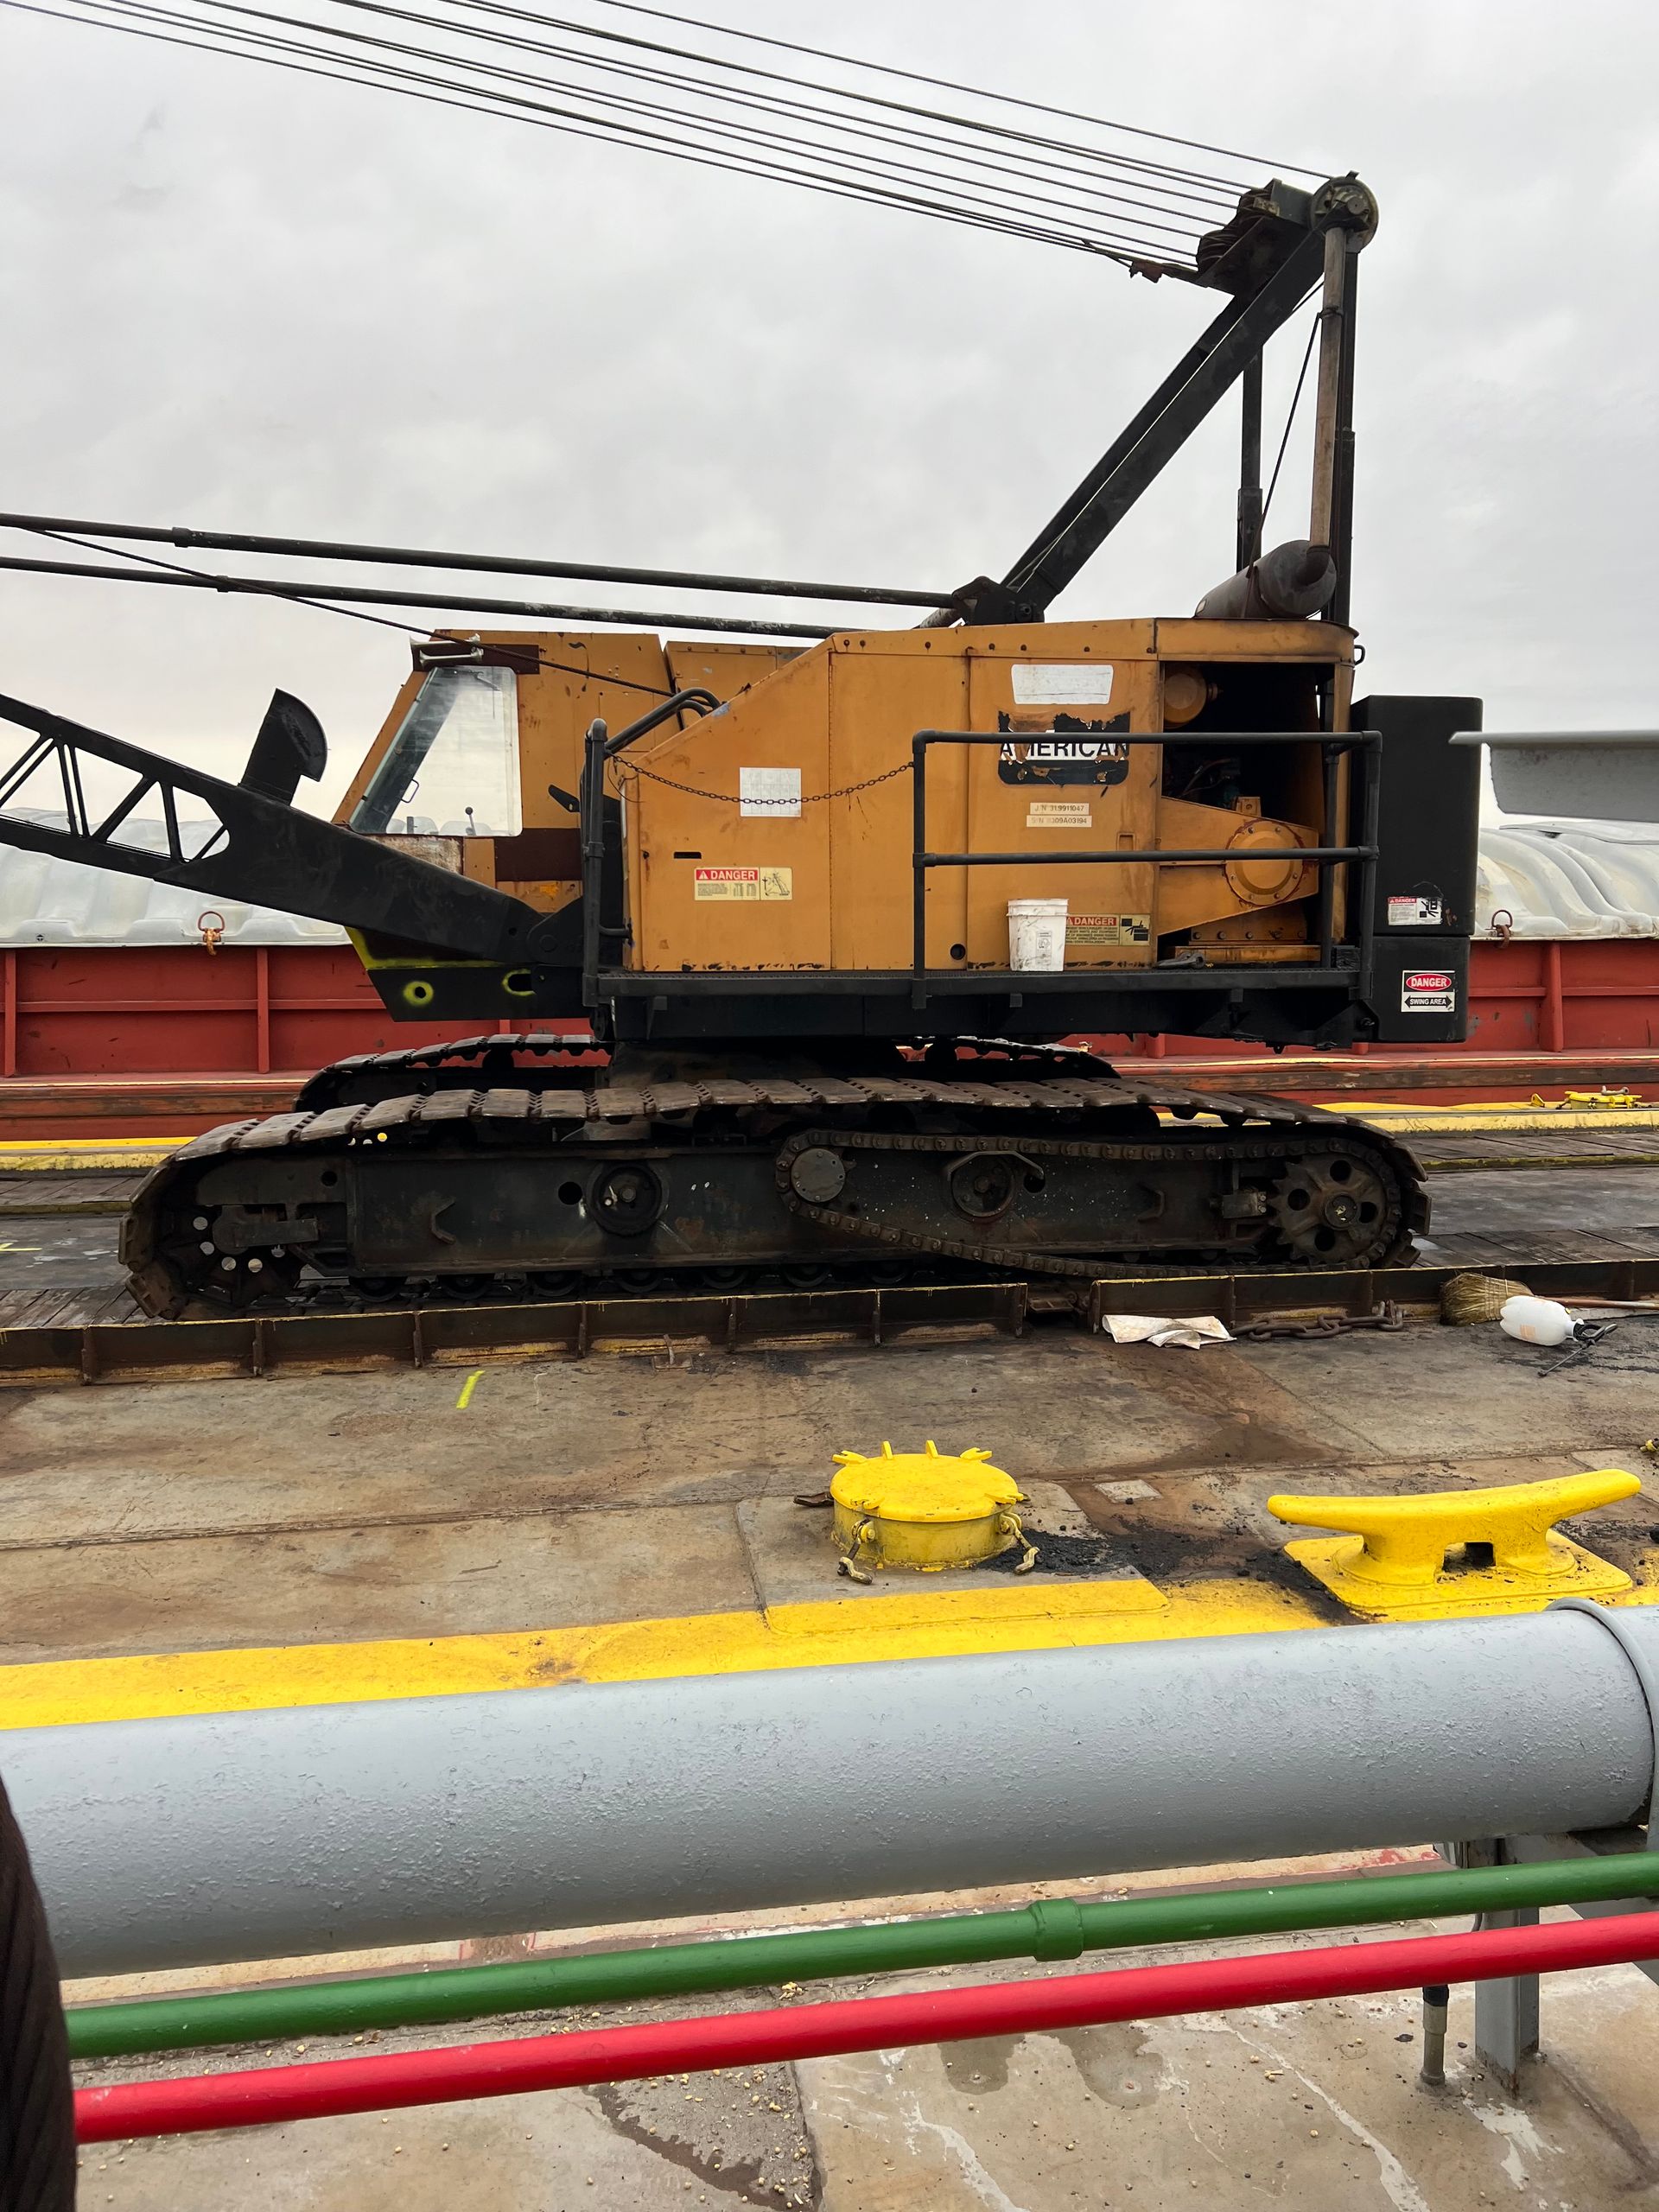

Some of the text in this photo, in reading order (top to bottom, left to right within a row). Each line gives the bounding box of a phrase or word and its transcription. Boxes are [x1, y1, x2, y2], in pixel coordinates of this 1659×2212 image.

[710, 870, 755, 880] DANGER
[1074, 917, 1115, 925] DANGER
[1411, 977, 1447, 988] DANGER
